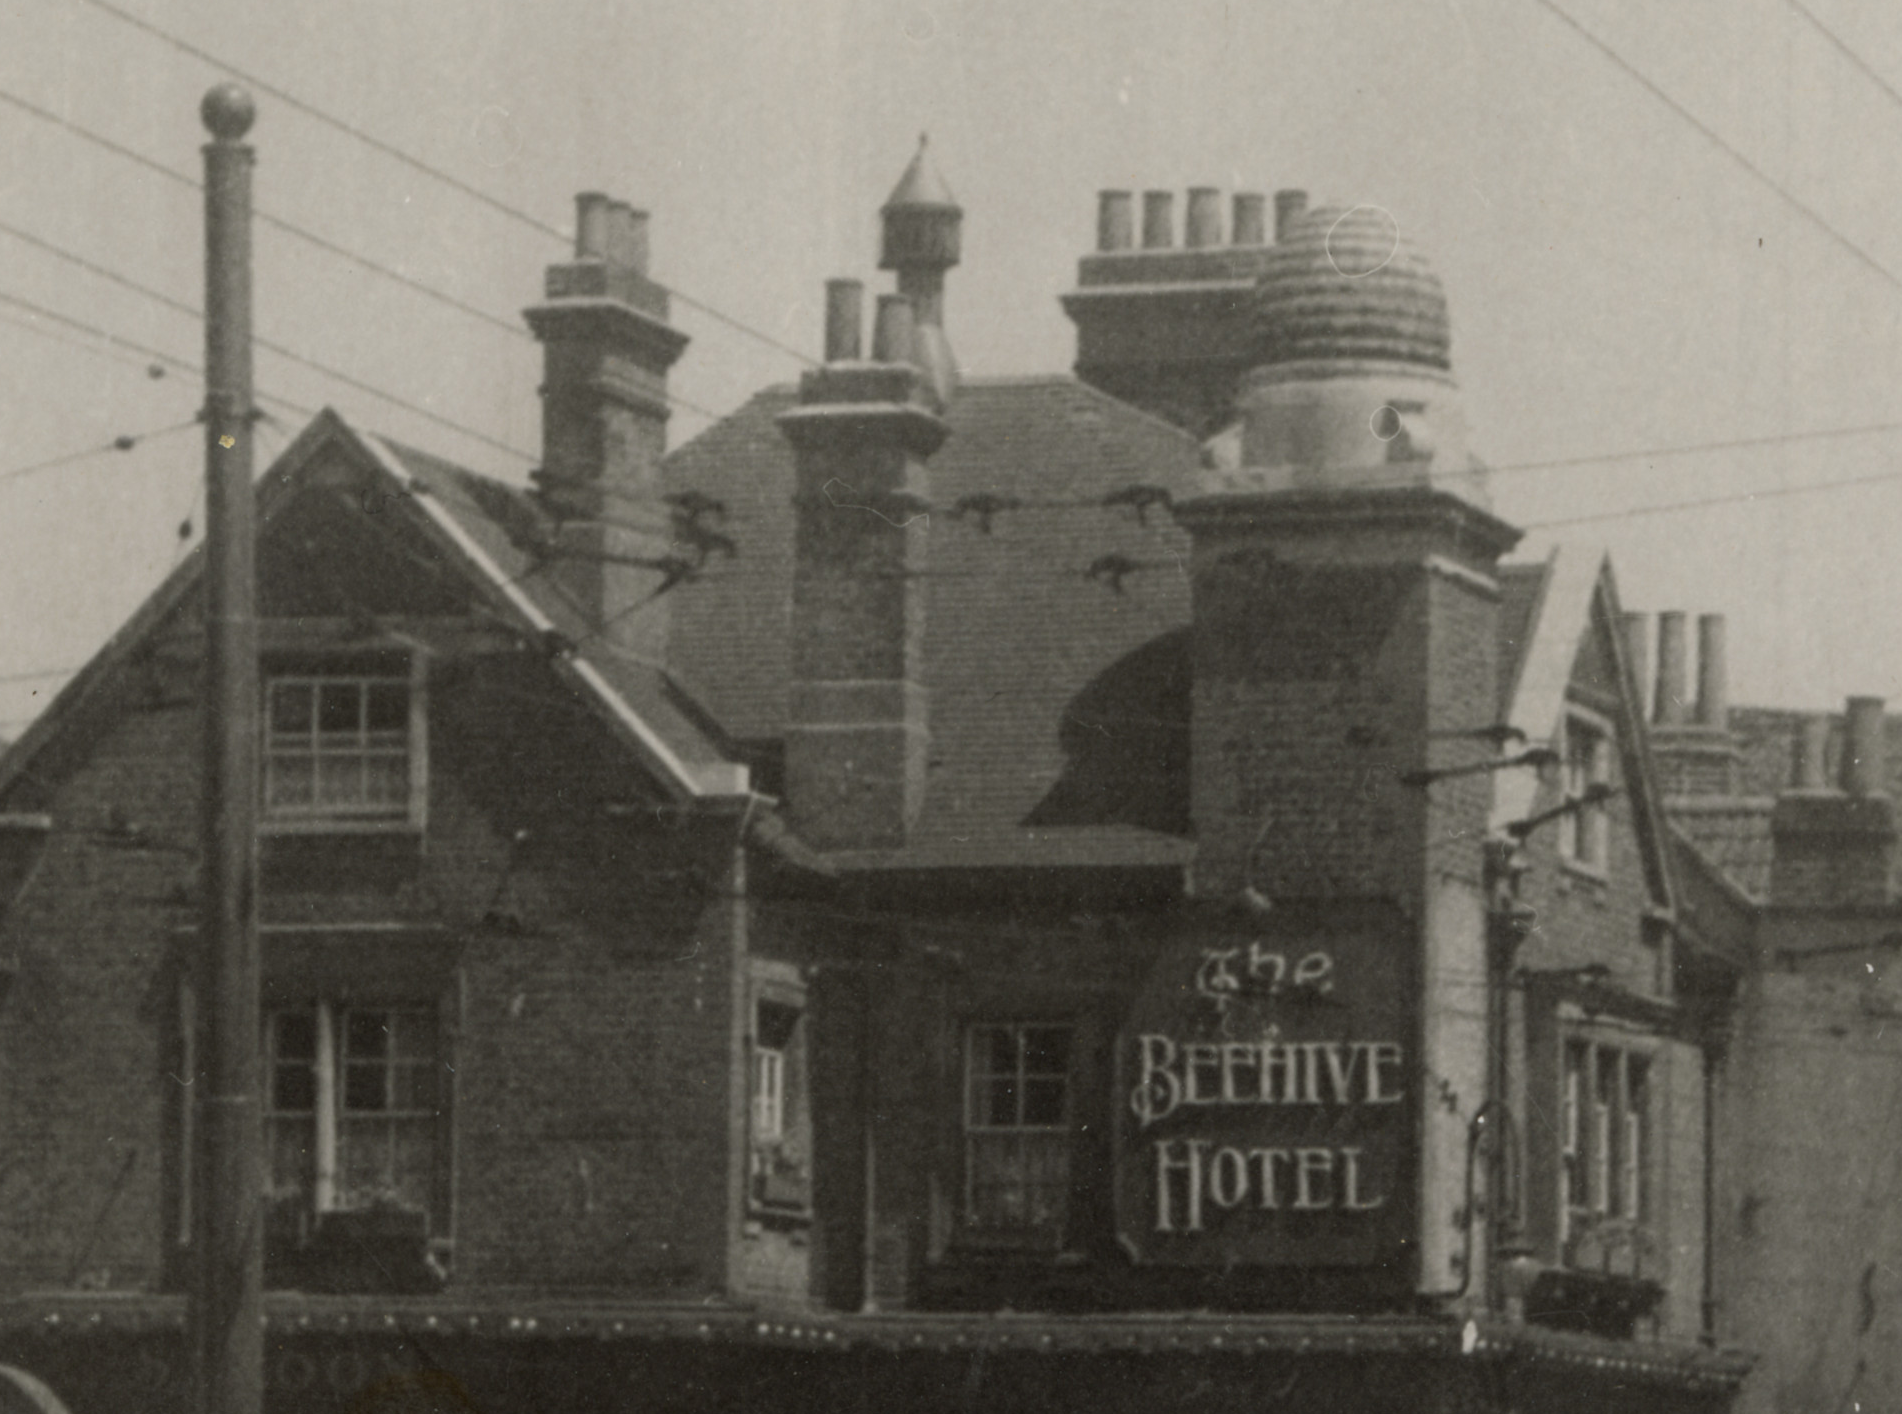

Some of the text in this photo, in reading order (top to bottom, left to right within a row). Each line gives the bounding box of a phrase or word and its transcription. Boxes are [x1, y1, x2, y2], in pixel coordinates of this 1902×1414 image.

[1196, 940, 1334, 1011] The
[1129, 1033, 1405, 1127] BEEHIVE
[1154, 1138, 1384, 1232] HOTEL
